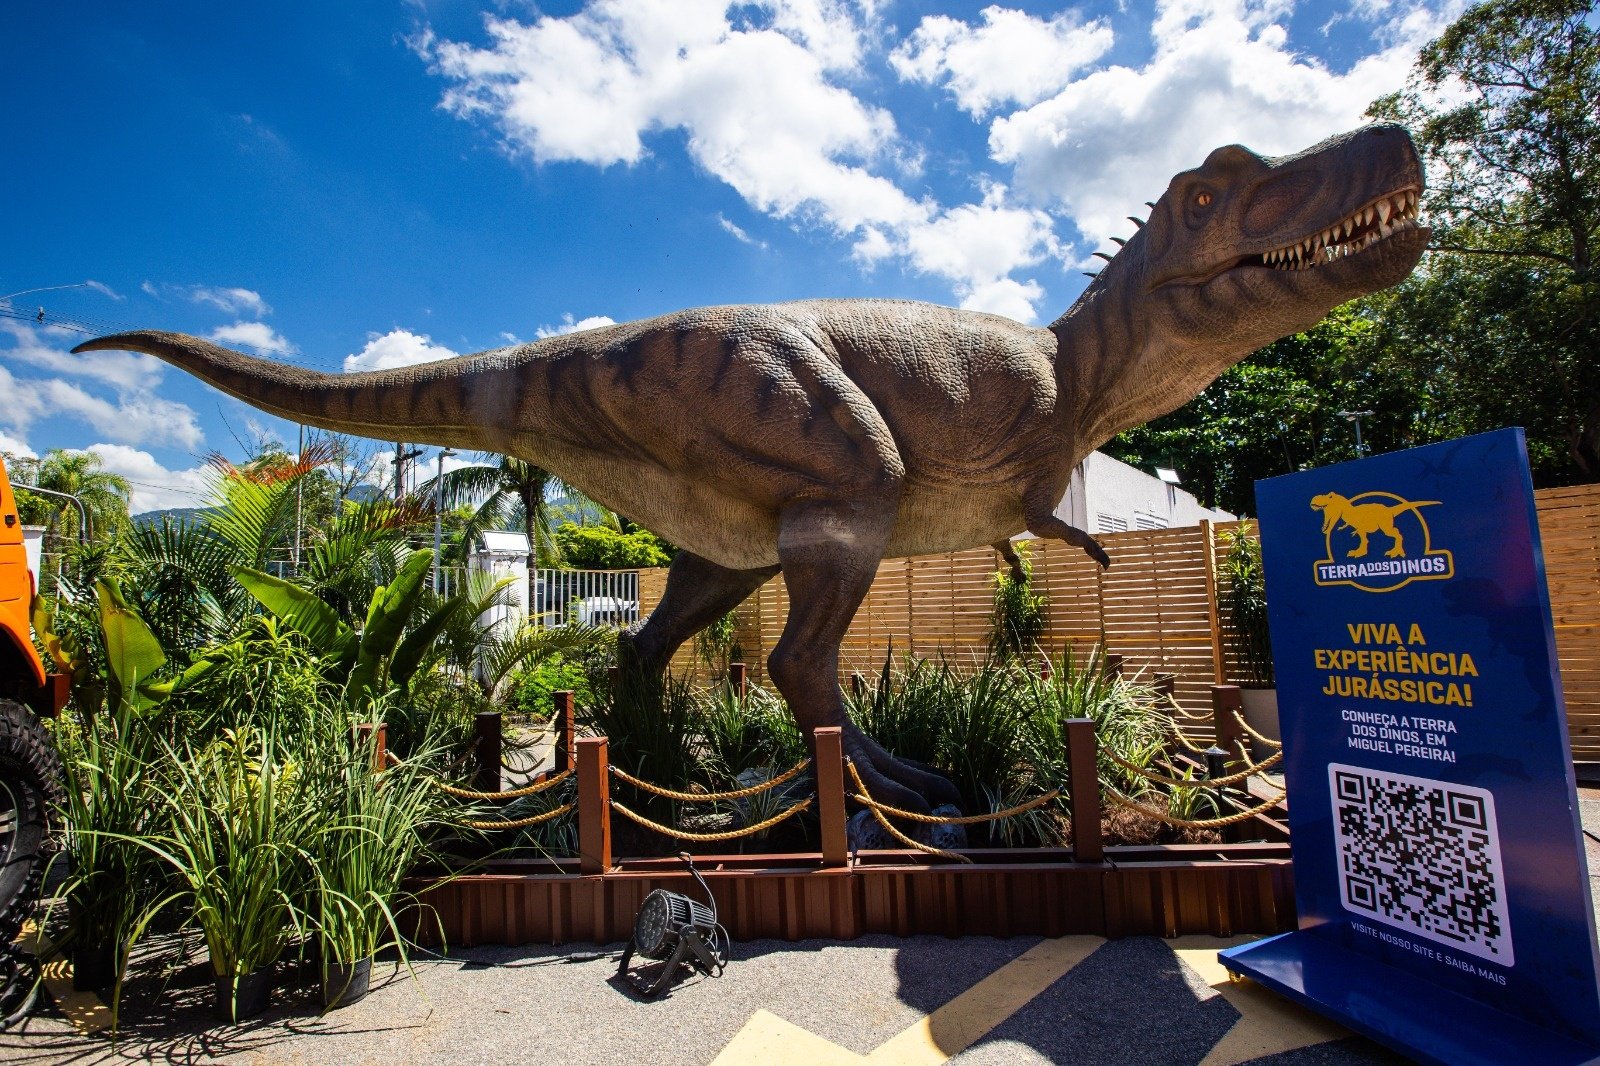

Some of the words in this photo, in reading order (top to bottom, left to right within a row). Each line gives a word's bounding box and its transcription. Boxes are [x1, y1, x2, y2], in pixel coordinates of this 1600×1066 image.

[1319, 563, 1368, 579] TERRA
[1368, 562, 1390, 573] DOS
[1390, 557, 1445, 575] DINOS
[1347, 623, 1403, 645] VIVA
[1408, 623, 1426, 645] A
[1314, 645, 1479, 677] EXPERIÊNCIA
[1323, 672, 1473, 707] JURÁSSICA!
[1342, 710, 1398, 728] CONHEÇA
[1401, 716, 1410, 728] A
[1411, 716, 1457, 733] TERRA
[1352, 724, 1377, 737] DOS
[1379, 727, 1423, 745] DINOS,
[1426, 733, 1447, 746] EM
[1348, 737, 1393, 754] MIGUEL
[1395, 743, 1456, 763] PEREIRA!
[1351, 921, 1378, 938] VISITE
[1379, 931, 1411, 950] NOSSO
[1413, 944, 1434, 959] SITE
[1436, 952, 1443, 962] E
[1445, 956, 1476, 975] SAIBA
[1478, 967, 1507, 986] MAIS
